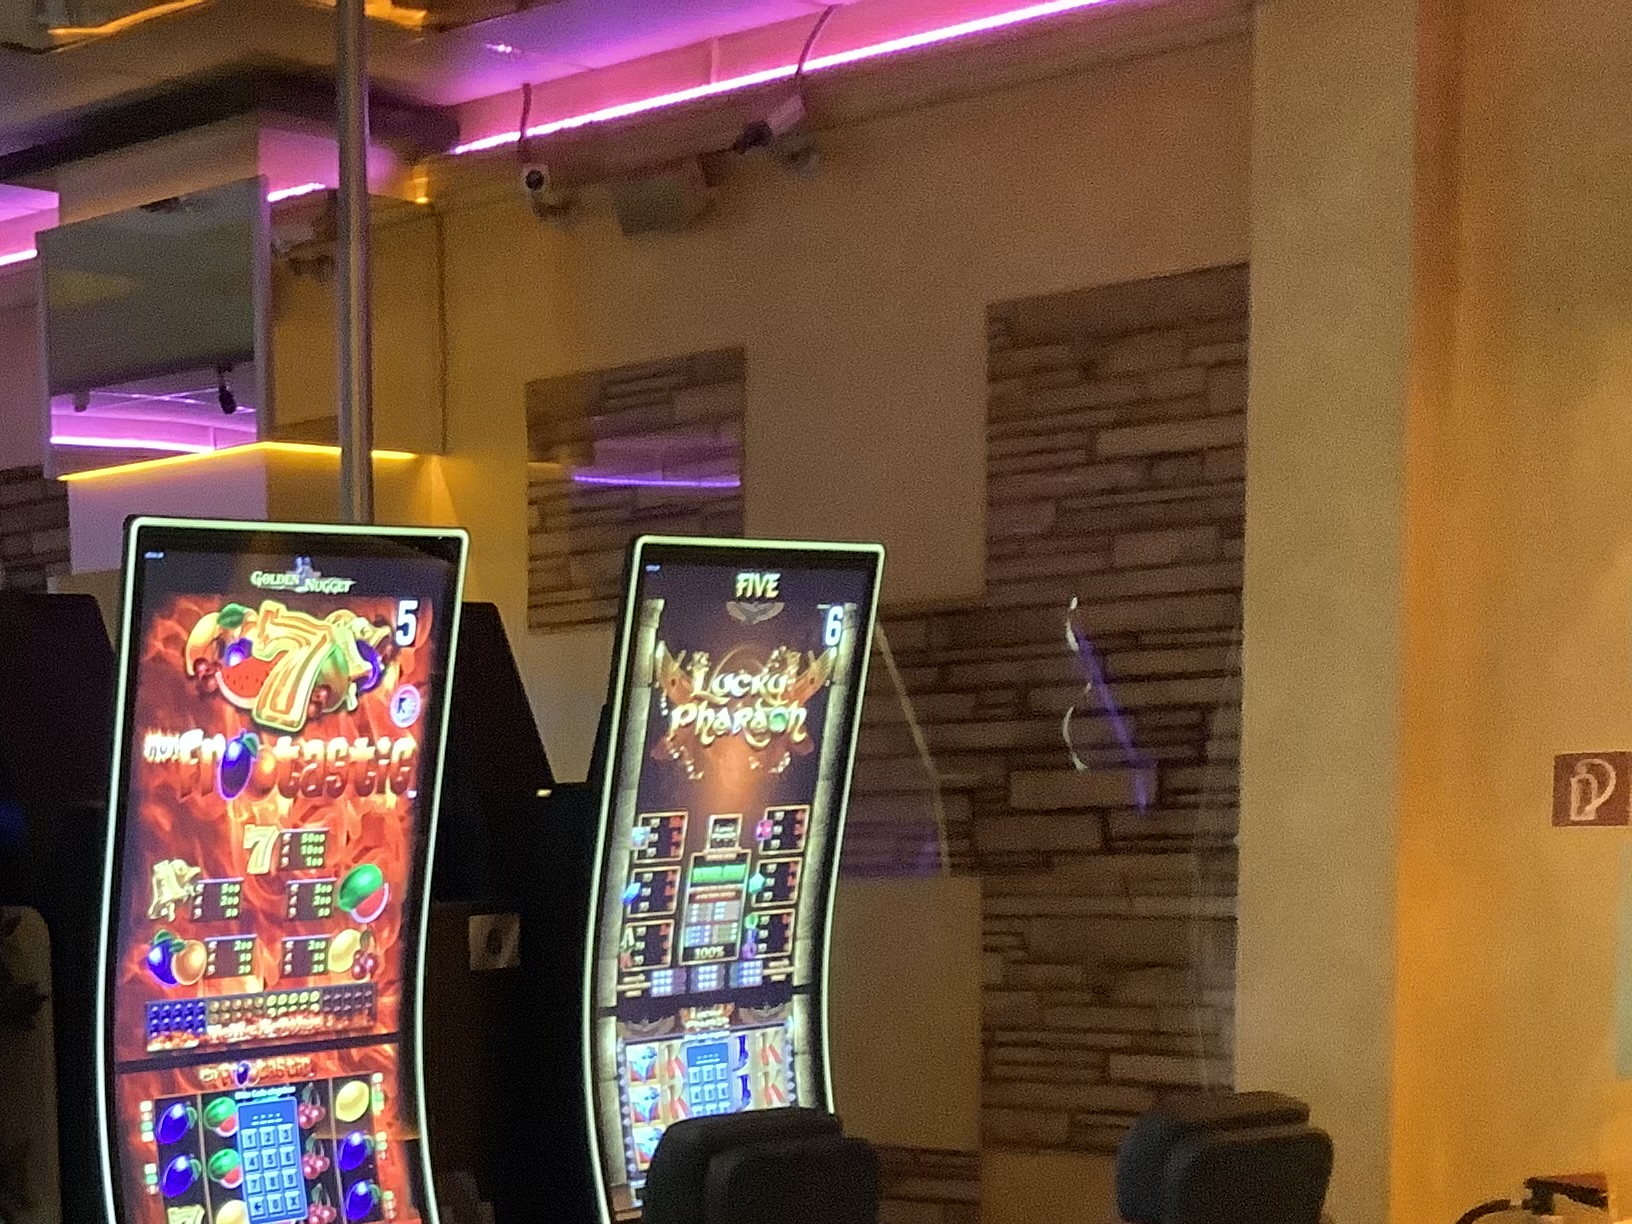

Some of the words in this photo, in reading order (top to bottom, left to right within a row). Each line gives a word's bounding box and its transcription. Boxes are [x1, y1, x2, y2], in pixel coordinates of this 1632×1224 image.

[304, 577, 357, 594] NUGGET
[736, 573, 780, 598] FIVE
[395, 600, 418, 646] 5
[825, 606, 843, 646] 6
[243, 824, 280, 874] 7
[694, 946, 725, 961] 100%
